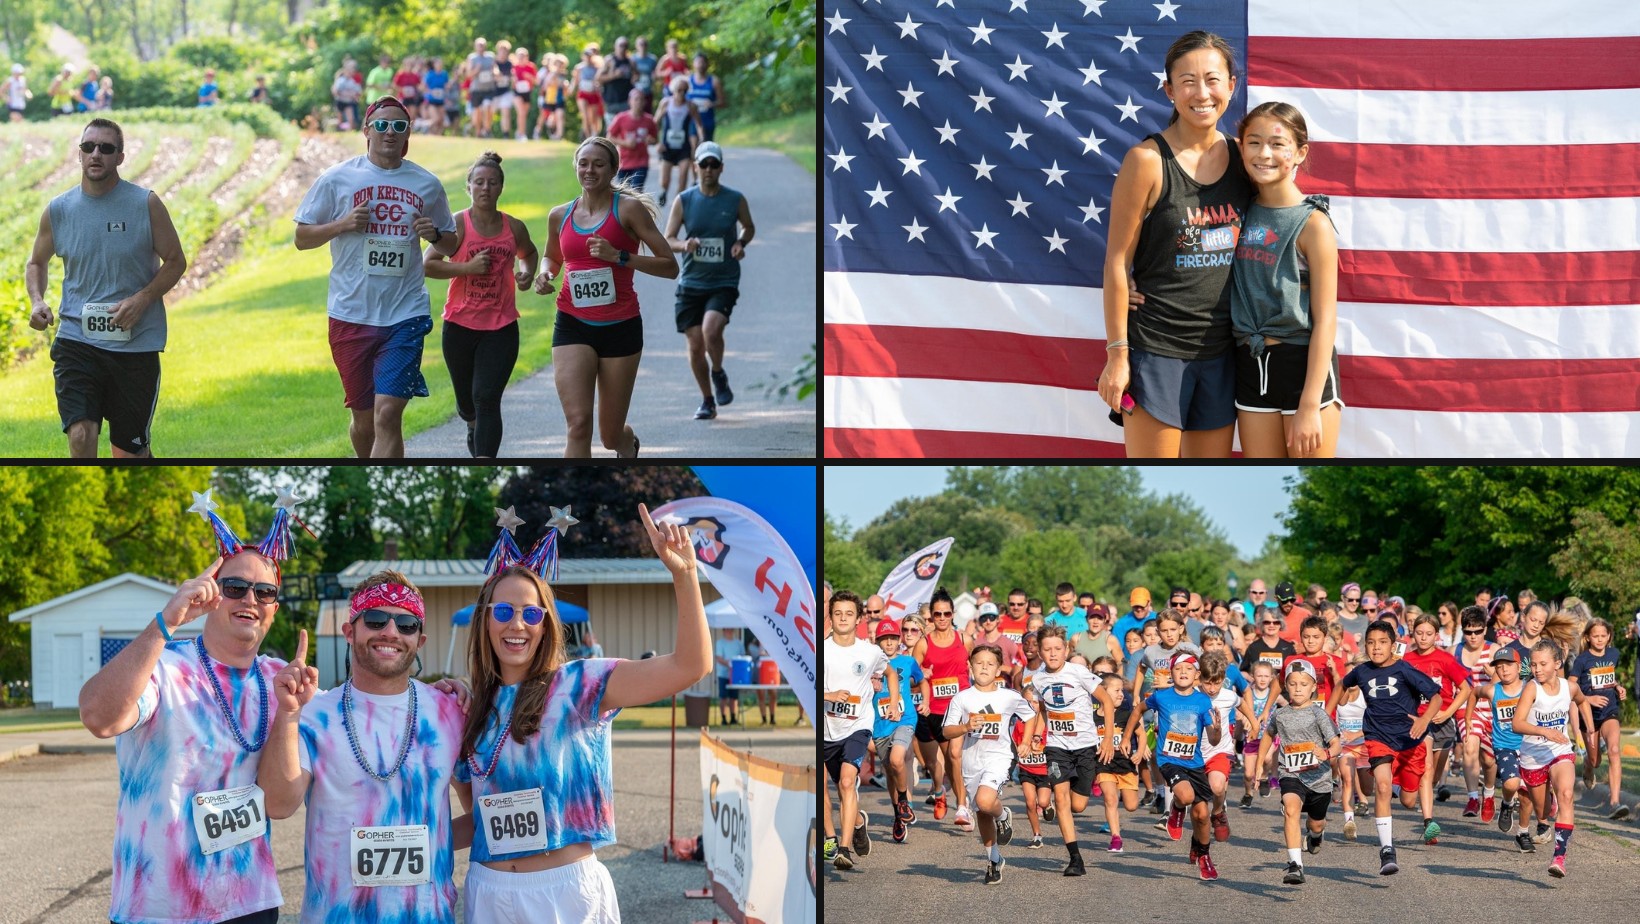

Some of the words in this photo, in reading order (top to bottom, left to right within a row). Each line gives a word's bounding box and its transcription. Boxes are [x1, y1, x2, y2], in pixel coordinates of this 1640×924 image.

[353, 186, 374, 208] RON
[375, 203, 403, 222] CC
[1186, 203, 1239, 226] MAMA
[365, 222, 408, 236] INVITE
[1185, 225, 1195, 238] of
[1247, 229, 1264, 241] little
[1205, 229, 1232, 247] little
[696, 246, 722, 257] 6764
[368, 250, 404, 268] 6421
[1175, 252, 1234, 269] FIRECRAC
[574, 281, 610, 299] 6432
[1594, 674, 1614, 685] 1783
[935, 684, 958, 696] 1959
[831, 702, 857, 715] 1861
[881, 702, 903, 716] 11
[1049, 720, 1075, 732] 1845
[1167, 741, 1195, 755] 1844
[1287, 752, 1314, 767] 1727
[196, 794, 229, 806] GOPHER
[484, 797, 514, 807] GOPHER
[203, 798, 262, 839] 6451
[490, 810, 539, 841] 6469
[357, 829, 395, 839] GOPHER
[357, 846, 424, 876] 6775
